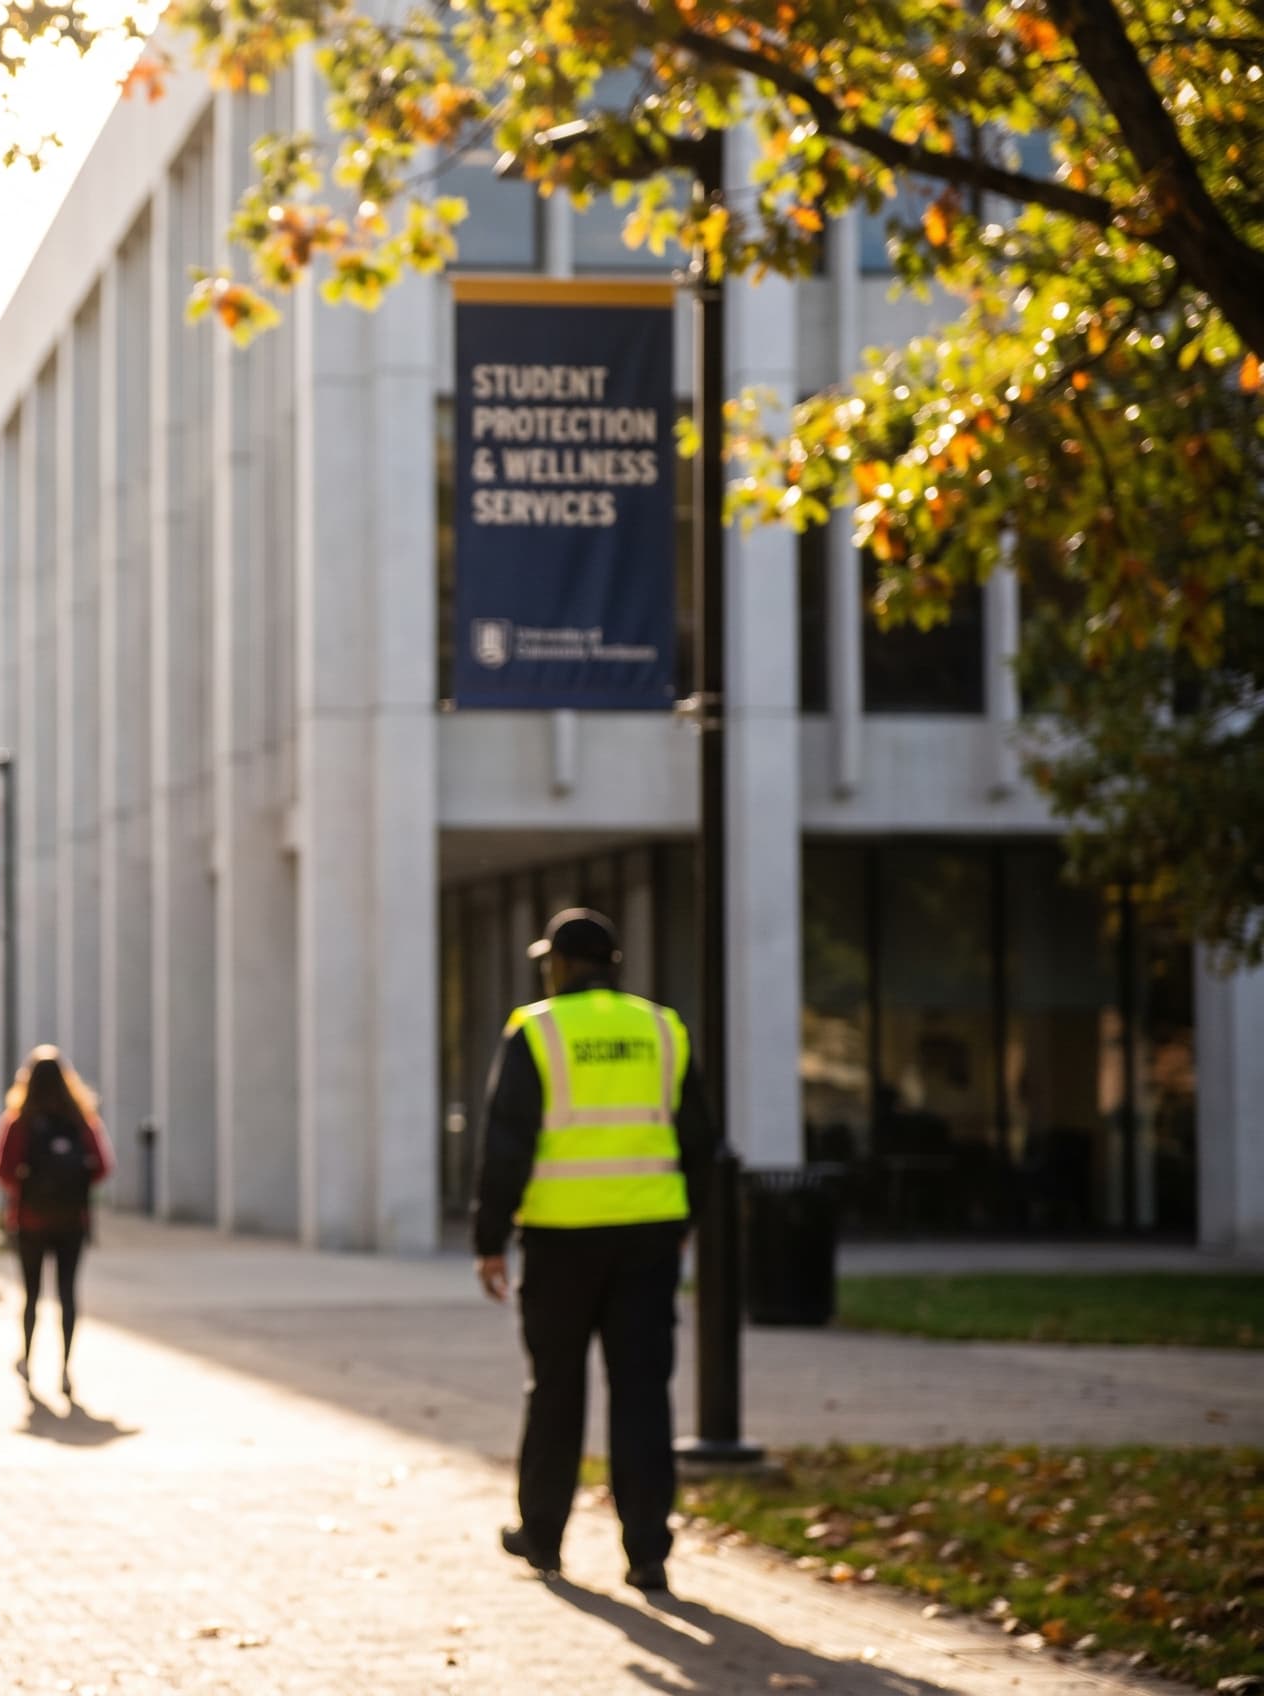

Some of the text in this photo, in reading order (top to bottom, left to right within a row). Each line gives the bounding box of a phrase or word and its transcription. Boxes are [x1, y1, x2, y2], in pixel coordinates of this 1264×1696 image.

[473, 364, 607, 398] STUDENT
[473, 406, 657, 442] PROTECTION
[472, 447, 658, 485] & WELLNESS
[473, 489, 616, 526] SERVICES
[574, 1037, 656, 1065] SECURITY
